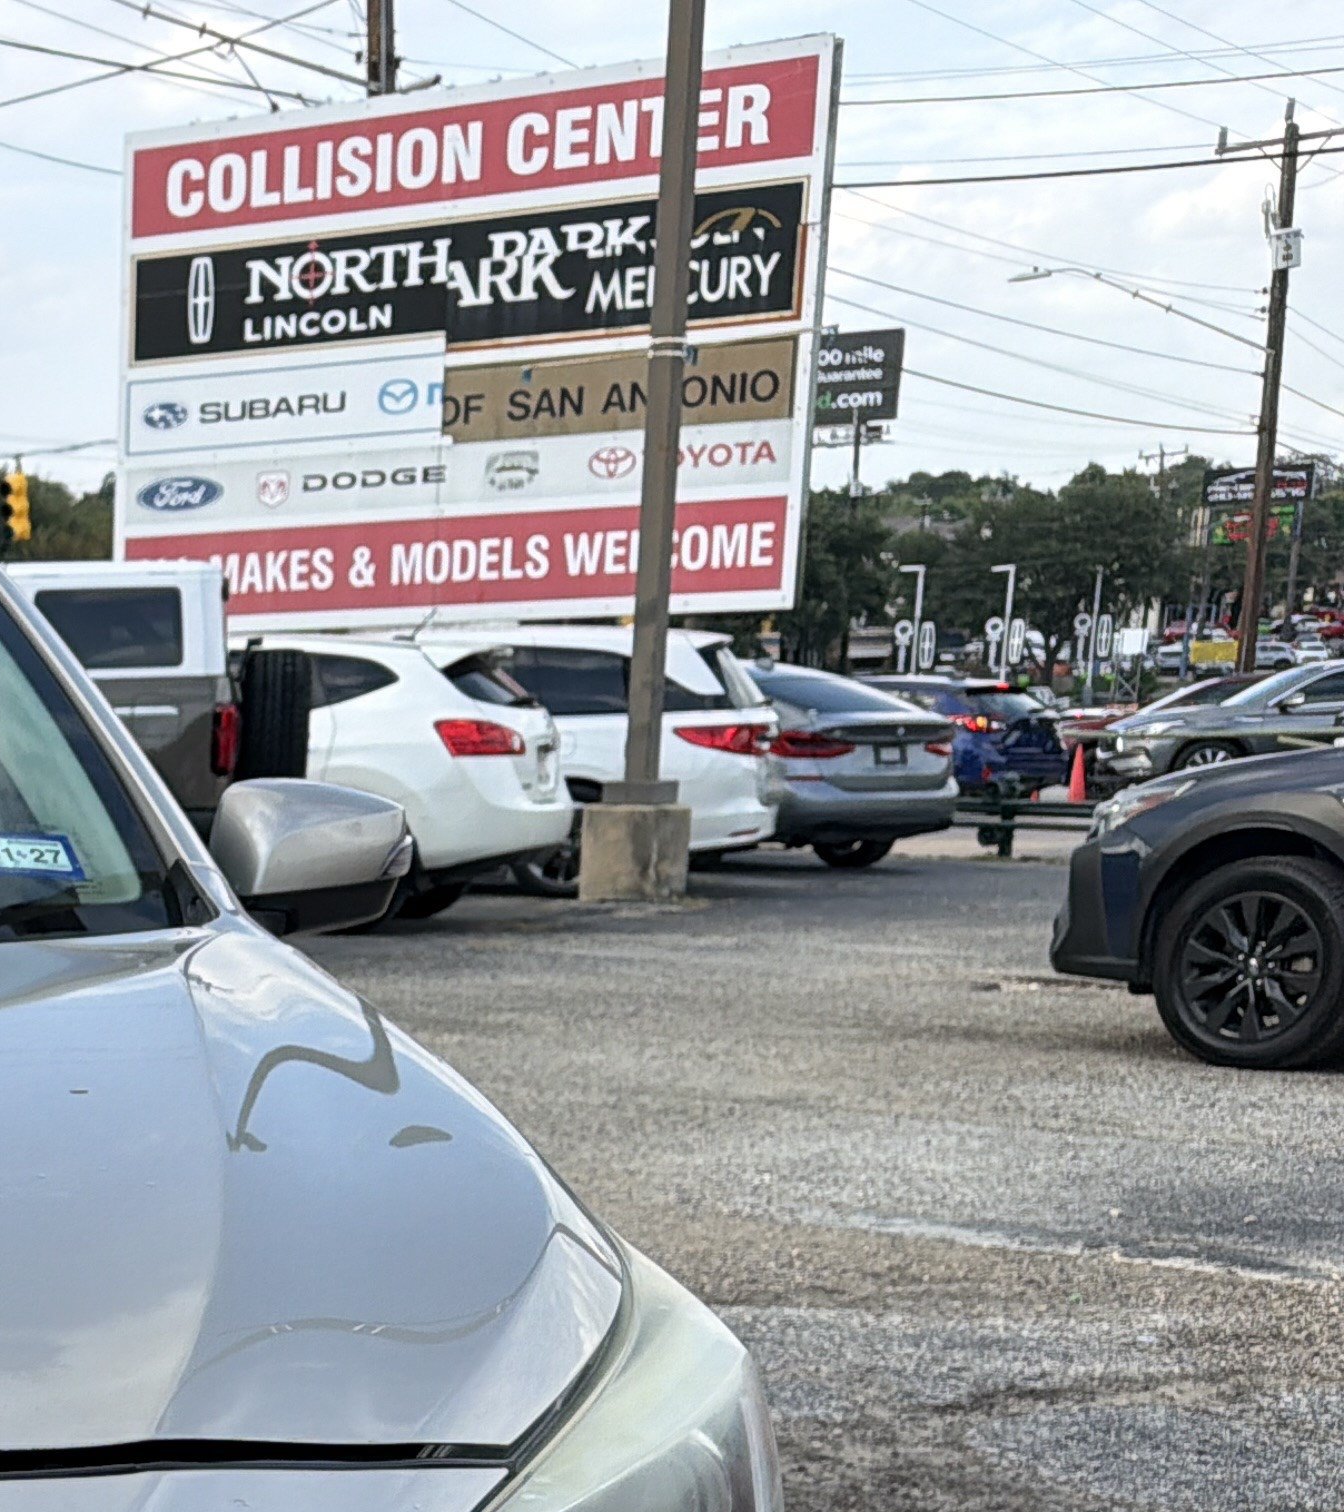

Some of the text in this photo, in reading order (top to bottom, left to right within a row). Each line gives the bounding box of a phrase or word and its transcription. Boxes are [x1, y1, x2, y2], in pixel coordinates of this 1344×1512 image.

[166, 83, 772, 218] COLLISION CENTER
[245, 238, 452, 305] NORTH
[585, 252, 781, 313] MEURY
[243, 304, 393, 342] LINCOLN
[199, 391, 347, 424] SUBARU
[507, 386, 585, 421] SAN
[601, 369, 780, 414] ANONIO
[644, 440, 777, 469] YOTA
[153, 475, 207, 507] Ford
[302, 465, 448, 493] DODGE
[210, 521, 776, 595] MAKES & MODELS WEOME
